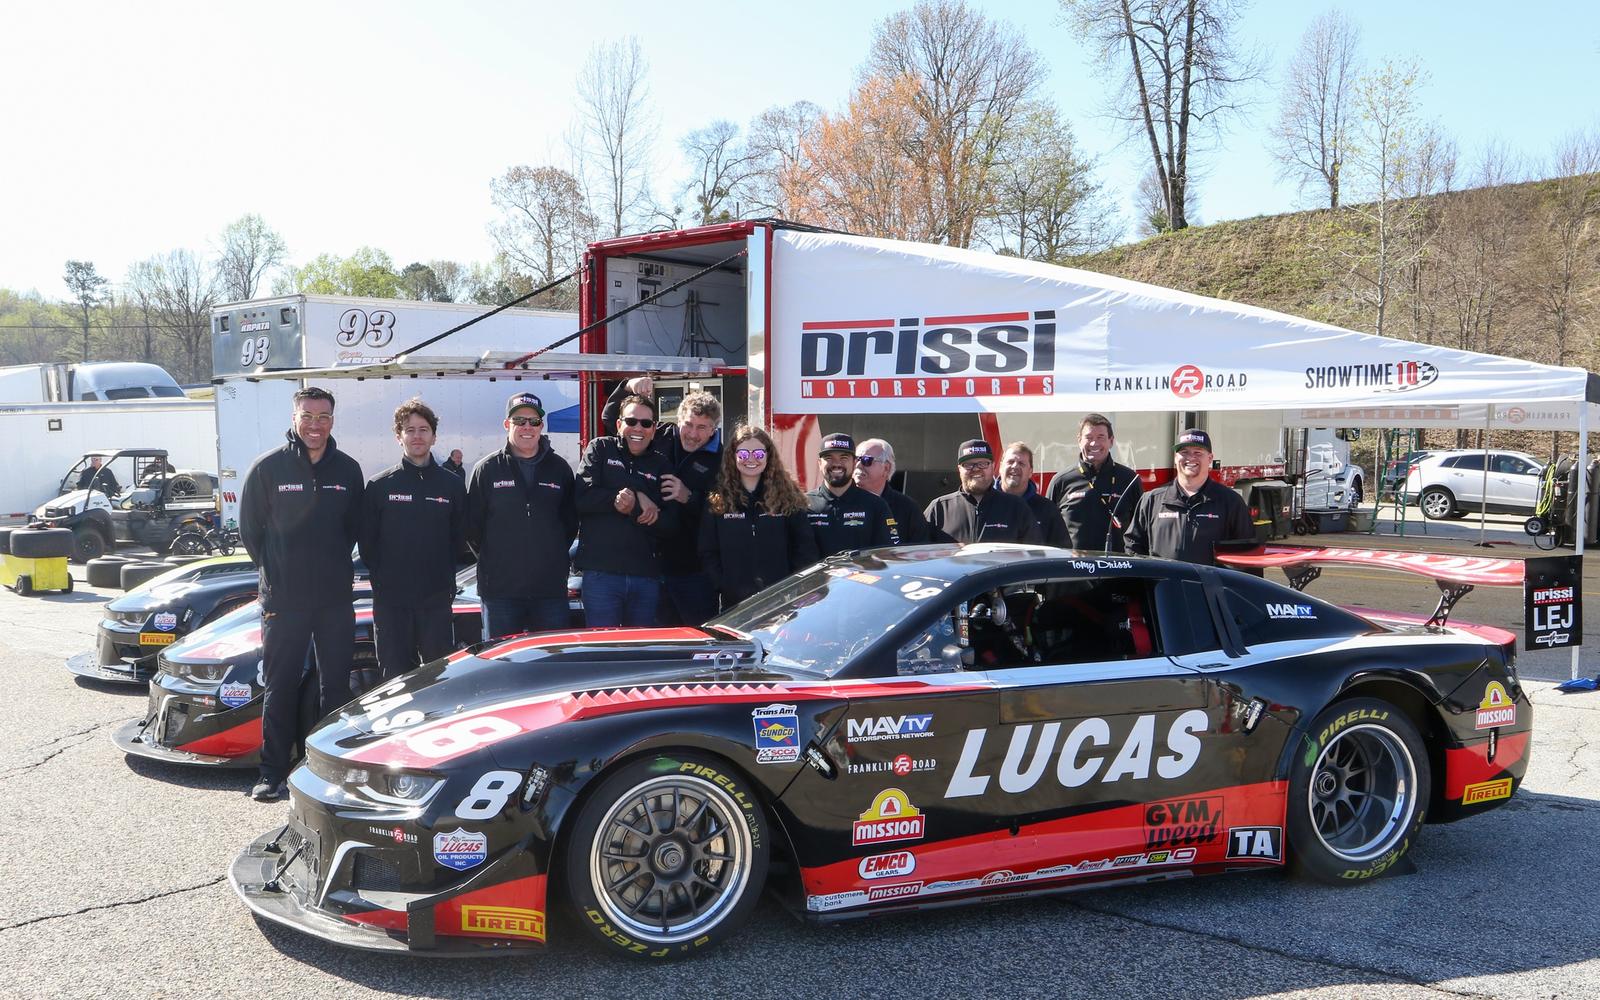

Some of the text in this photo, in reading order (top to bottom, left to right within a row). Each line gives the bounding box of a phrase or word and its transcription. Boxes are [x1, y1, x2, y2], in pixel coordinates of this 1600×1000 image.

[336, 308, 396, 348] 93
[241, 336, 271, 366] 93
[1095, 376, 1170, 391] FRANKLIN
[1205, 373, 1248, 388] ROAD
[1305, 361, 1418, 388] SHOWTIME 10
[802, 378, 1053, 397] MOTORSPORTS
[1095, 560, 1132, 569] Drissi
[1266, 603, 1312, 616] MAVTV
[1533, 604, 1574, 632] LEJ
[761, 729, 794, 738] SUNOCO
[847, 714, 933, 738] MAVTV
[1319, 708, 1390, 747] PIRELLI
[406, 716, 523, 759] 8
[847, 731, 935, 744] MOTORSPORTS NETWORK
[771, 749, 797, 757] SCCA
[944, 709, 1209, 799] LUCAS
[848, 763, 893, 775] FRANKLIN
[913, 759, 937, 770] ROAD
[454, 770, 523, 821] 8
[679, 761, 754, 811] PIRELLI
[1465, 781, 1509, 801] PIRELLI
[1146, 800, 1210, 827] GYM
[369, 826, 394, 837] FRANKLIN
[404, 834, 418, 843] ROAD
[1235, 830, 1274, 856] TA
[440, 842, 484, 852] LUCAS
[864, 853, 909, 873] EMCO
[875, 869, 899, 877] GEARS
[824, 890, 865, 901] customers
[824, 899, 843, 907] bank
[467, 909, 545, 935] PIRELLI
[586, 908, 649, 955] ZERO
